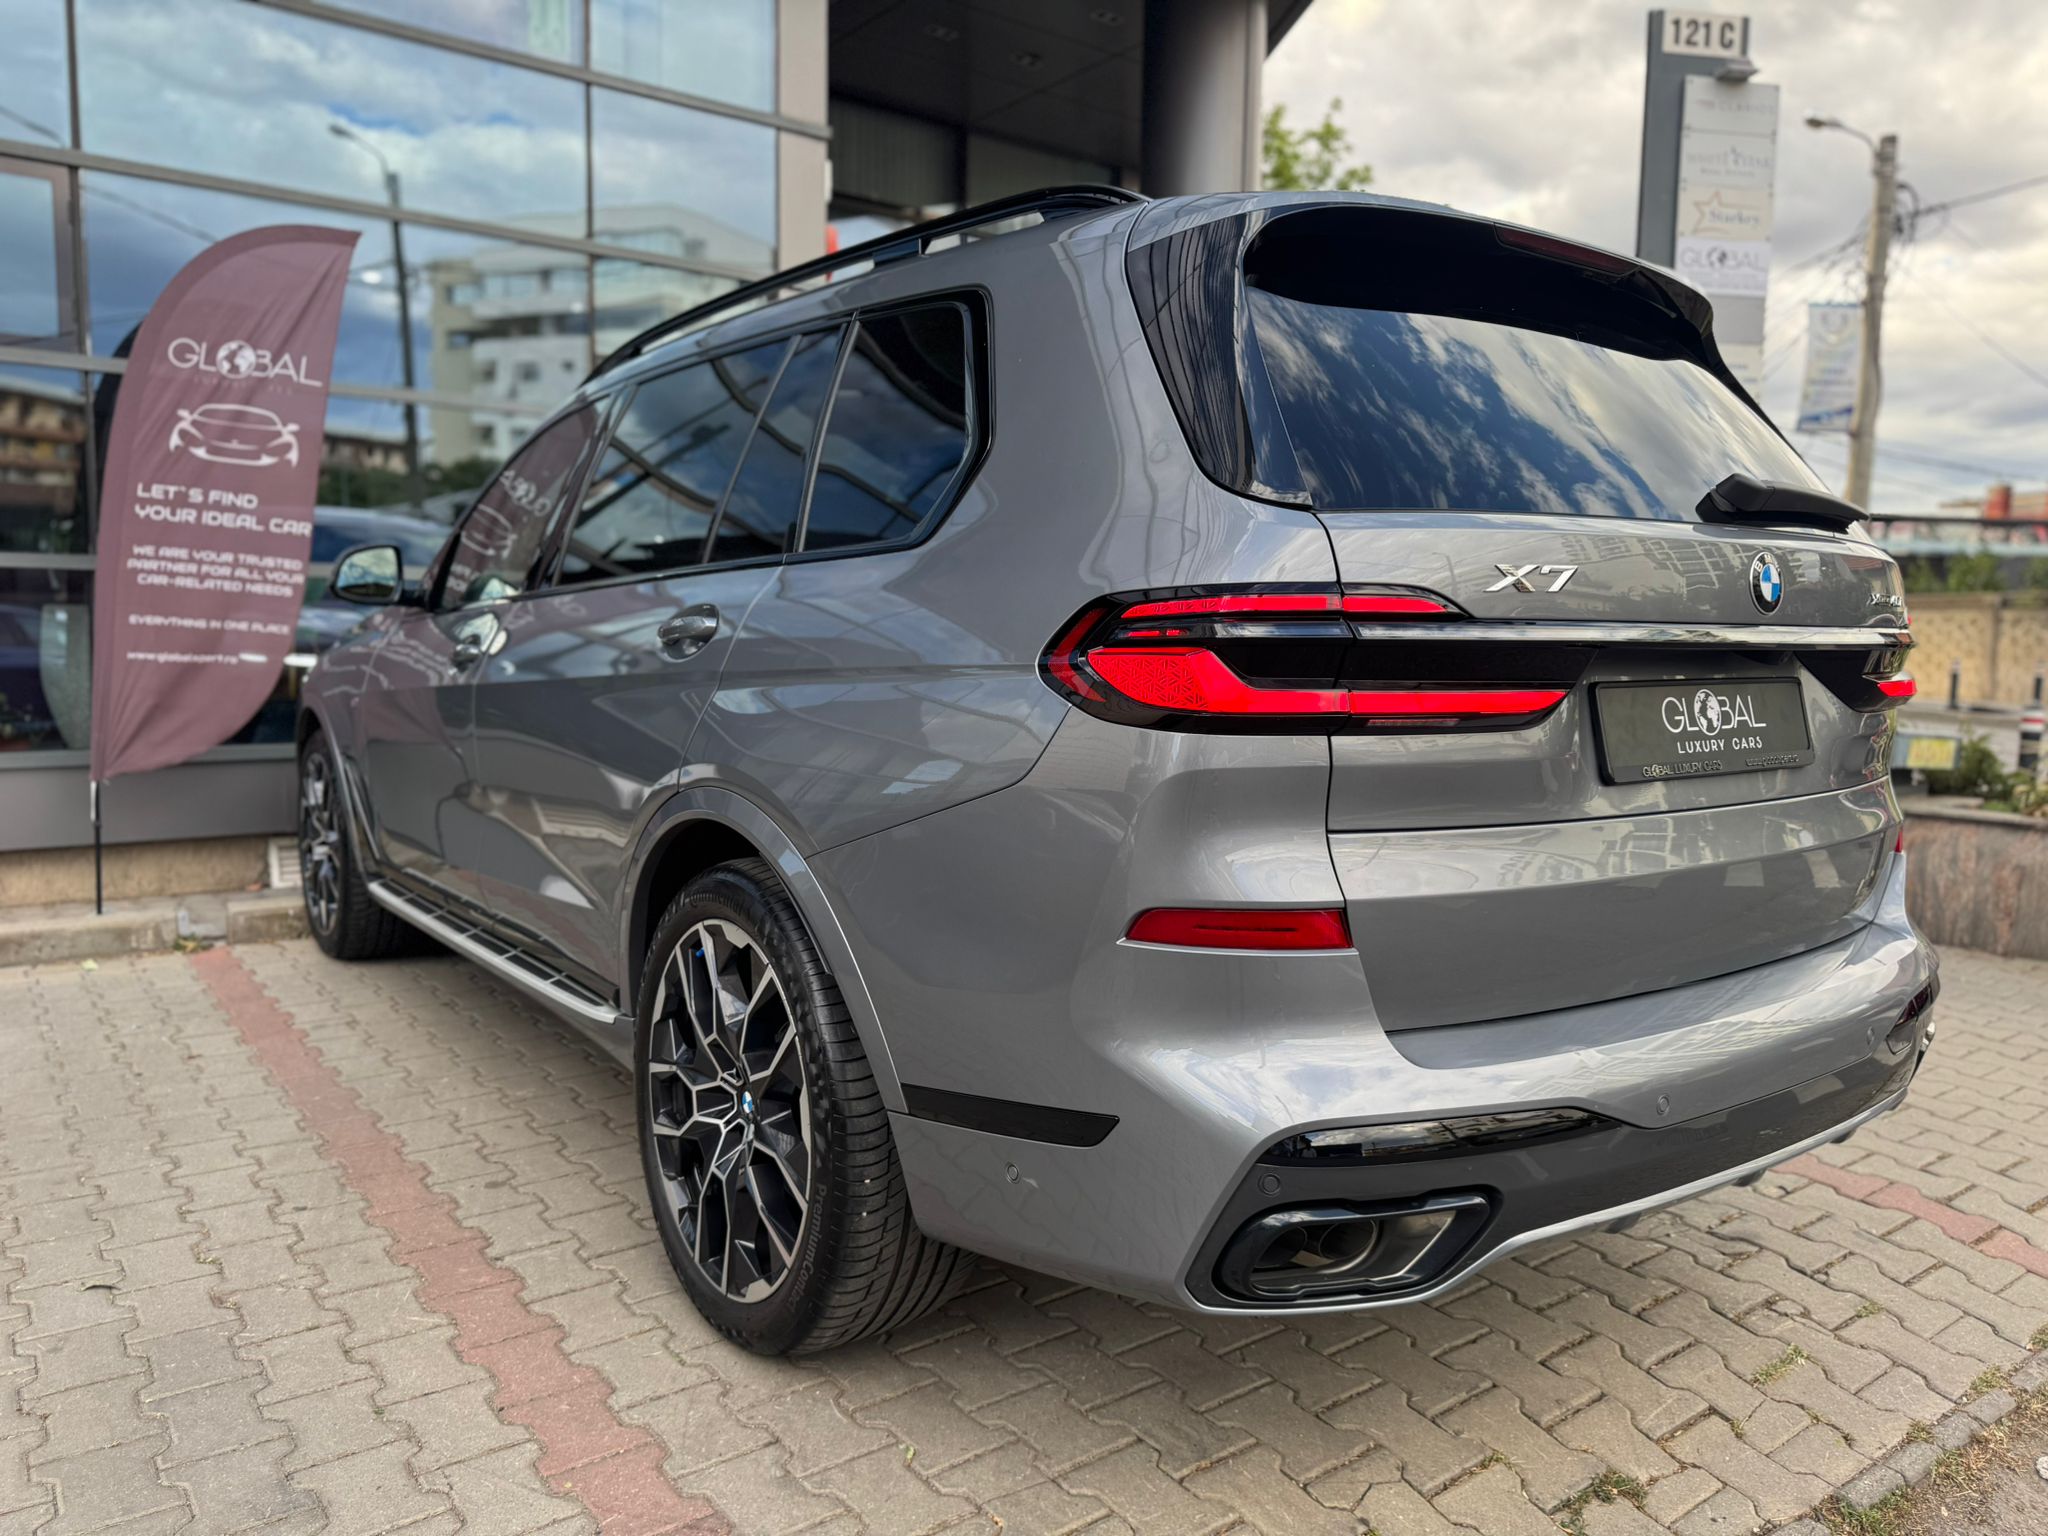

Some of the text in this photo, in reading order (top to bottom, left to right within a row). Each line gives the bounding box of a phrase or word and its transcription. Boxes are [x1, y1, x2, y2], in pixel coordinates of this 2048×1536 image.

[1671, 18, 1711, 47] 121
[168, 338, 323, 387] GLOBAL
[208, 489, 259, 509] FIND
[135, 503, 313, 537] YOUR IDEAL CAR
[132, 544, 303, 571] WE ARE YOUR TRUSTED
[127, 558, 305, 585] PARTNER FOR ALL YOUR
[1482, 563, 1580, 594] X7
[137, 573, 294, 598] CAR-RELATED NEEDS
[128, 614, 291, 636] EVERYTHING IN ONE PLACE
[1662, 688, 1767, 736] GLOBAL
[1677, 736, 1763, 754] LUXURY CARS
[1642, 760, 1724, 778] GLOBAL LUXURY CARS
